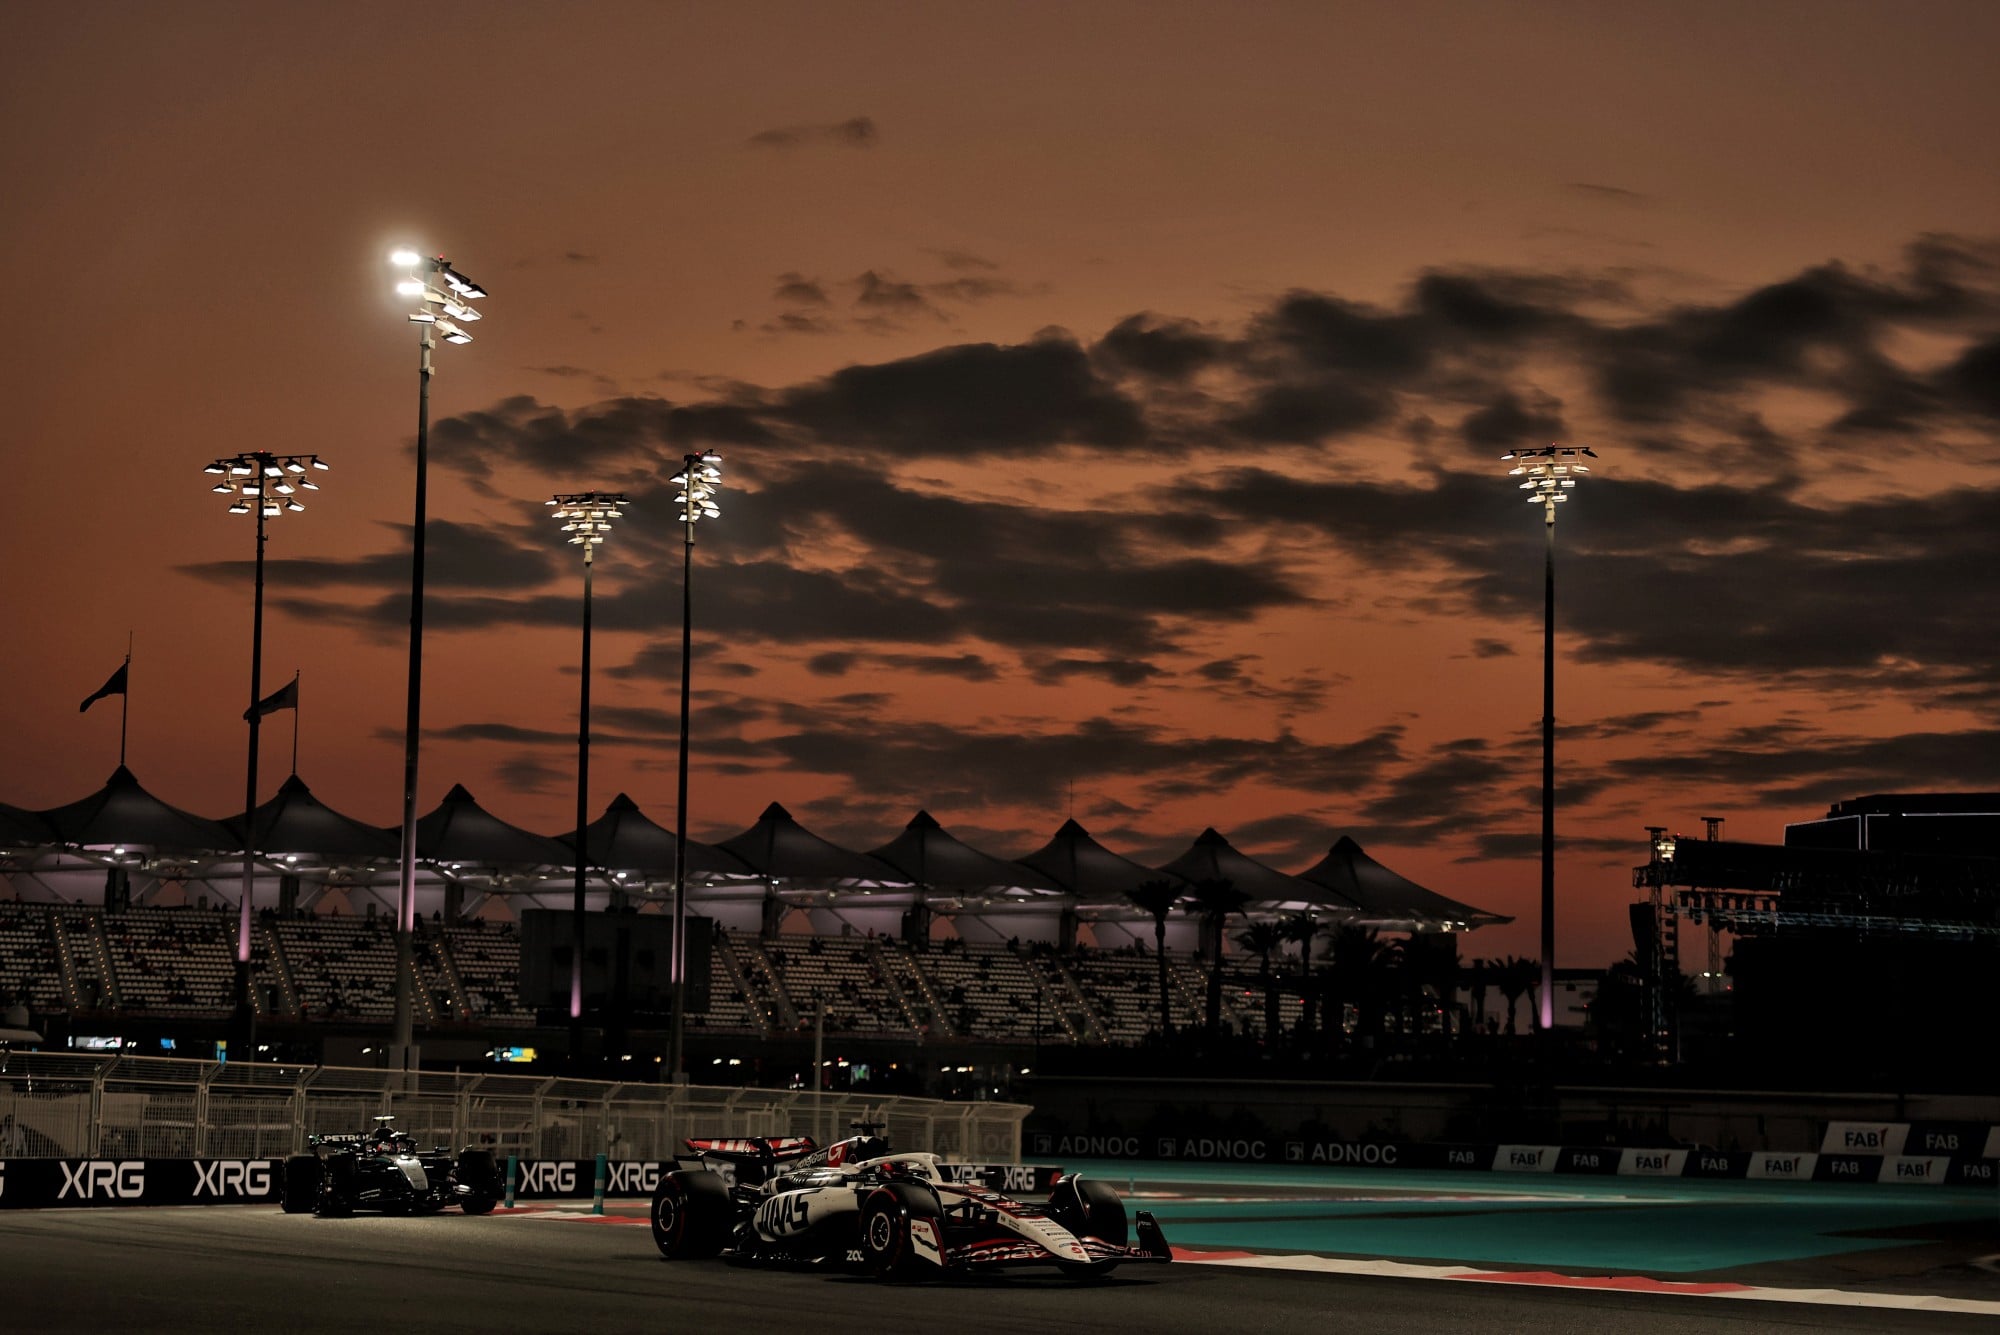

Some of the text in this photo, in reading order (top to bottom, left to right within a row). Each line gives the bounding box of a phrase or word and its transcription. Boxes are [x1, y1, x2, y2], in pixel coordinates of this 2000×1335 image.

[1058, 1136, 1140, 1156] ADNOC
[1845, 1132, 1877, 1147] FAB
[1925, 1134, 1959, 1150] FAB
[1183, 1139, 1267, 1161] ADNOC
[1311, 1143, 1398, 1166] ADNOC
[1448, 1150, 1475, 1164] FAB
[1510, 1152, 1536, 1165] FAB
[1572, 1155, 1600, 1168] FAB
[1636, 1157, 1662, 1169] FAB
[1700, 1158, 1728, 1171] FAB
[1766, 1160, 1793, 1173] FAB
[1831, 1161, 1860, 1175] FAB
[1897, 1164, 1924, 1177] FAB
[1963, 1165, 1991, 1179] FAB
[56, 1160, 145, 1199] XRG
[191, 1160, 271, 1197] XRG
[519, 1161, 576, 1192] XRG
[606, 1161, 660, 1192] XRG
[1003, 1167, 1036, 1191] XRG
